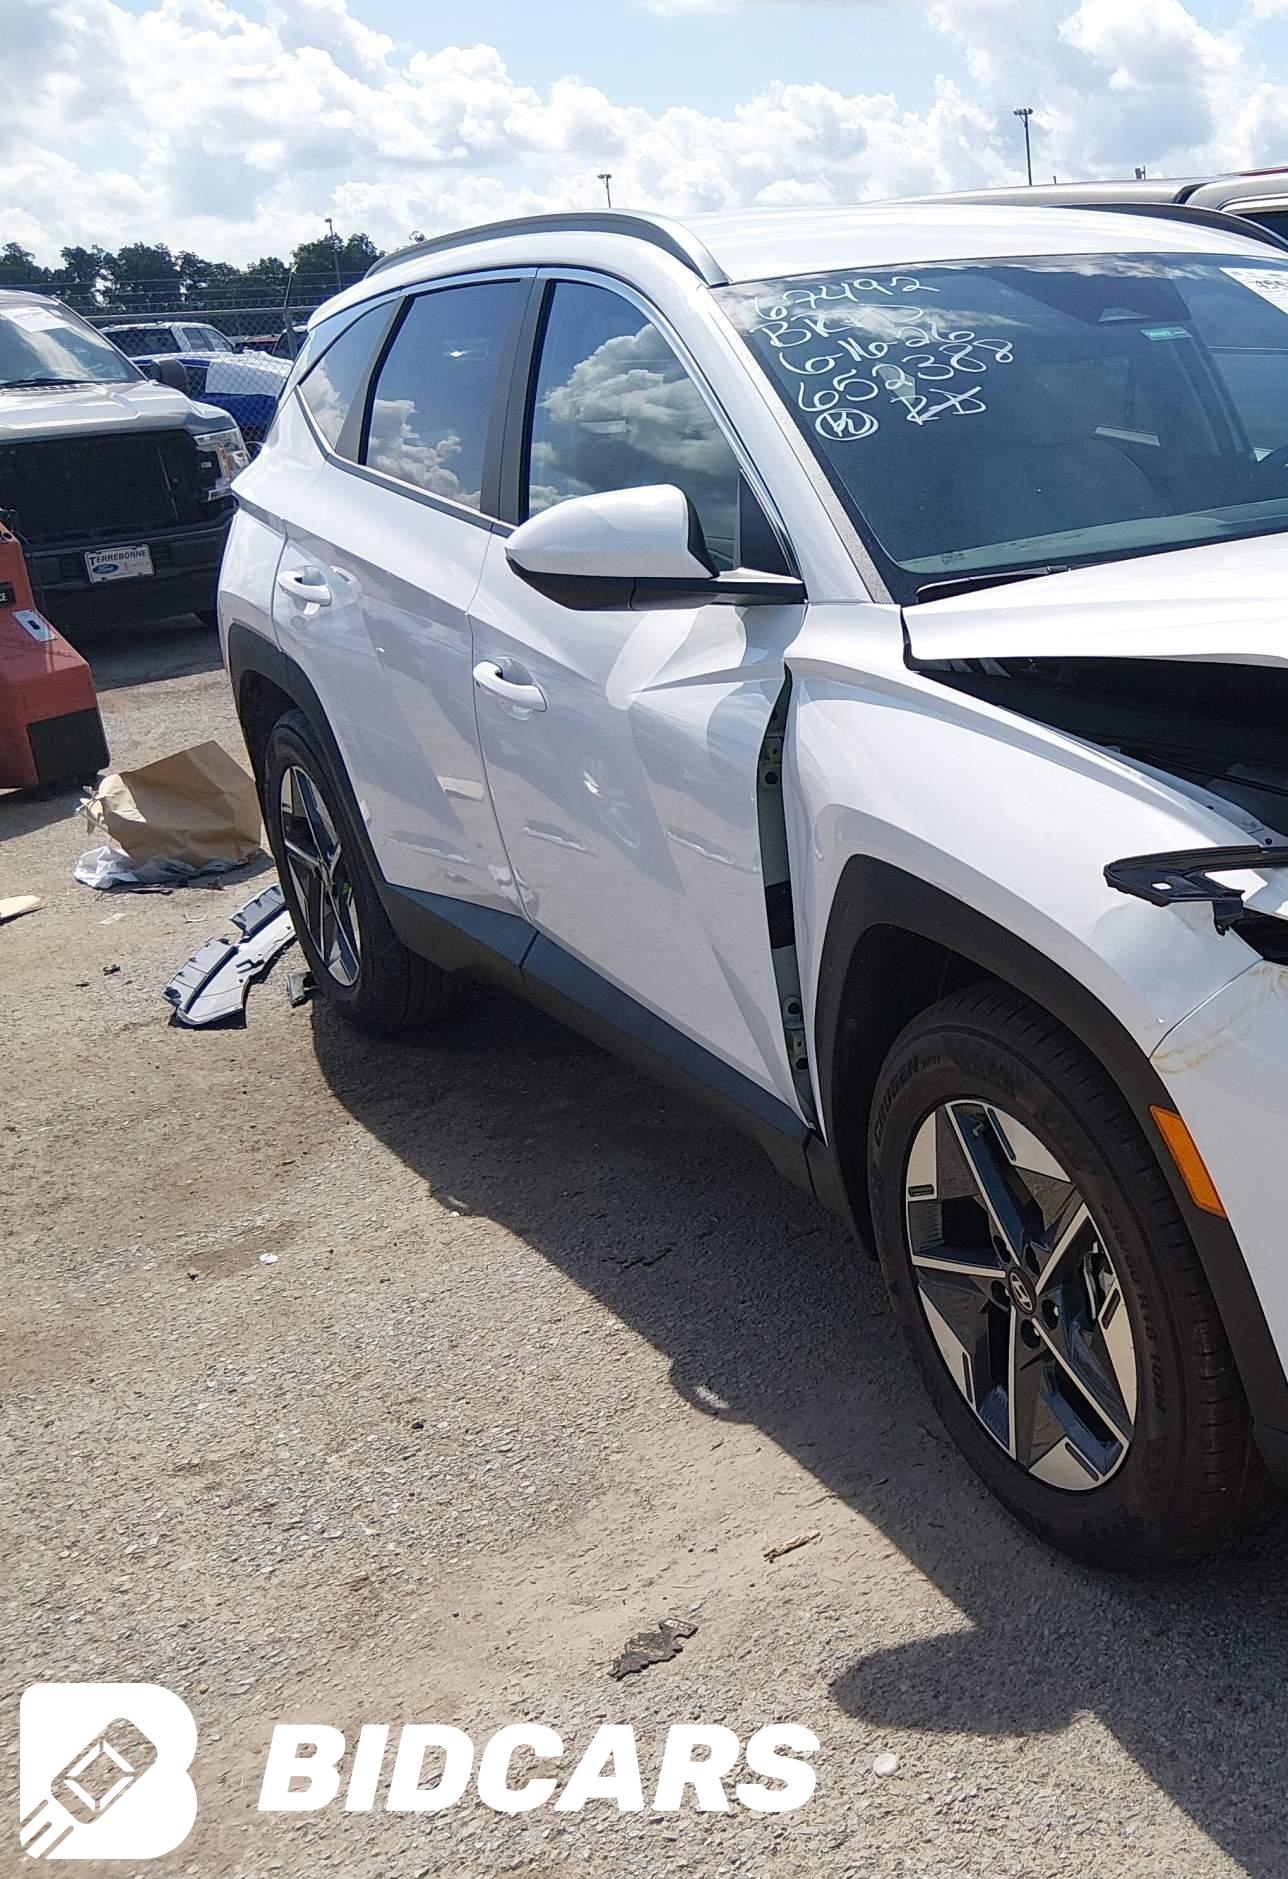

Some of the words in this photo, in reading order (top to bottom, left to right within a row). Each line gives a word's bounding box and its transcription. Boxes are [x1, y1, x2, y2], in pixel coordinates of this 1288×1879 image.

[755, 276, 941, 320] 67492
[799, 338, 1014, 412] 652388
[89, 550, 147, 566] TERREBONNE
